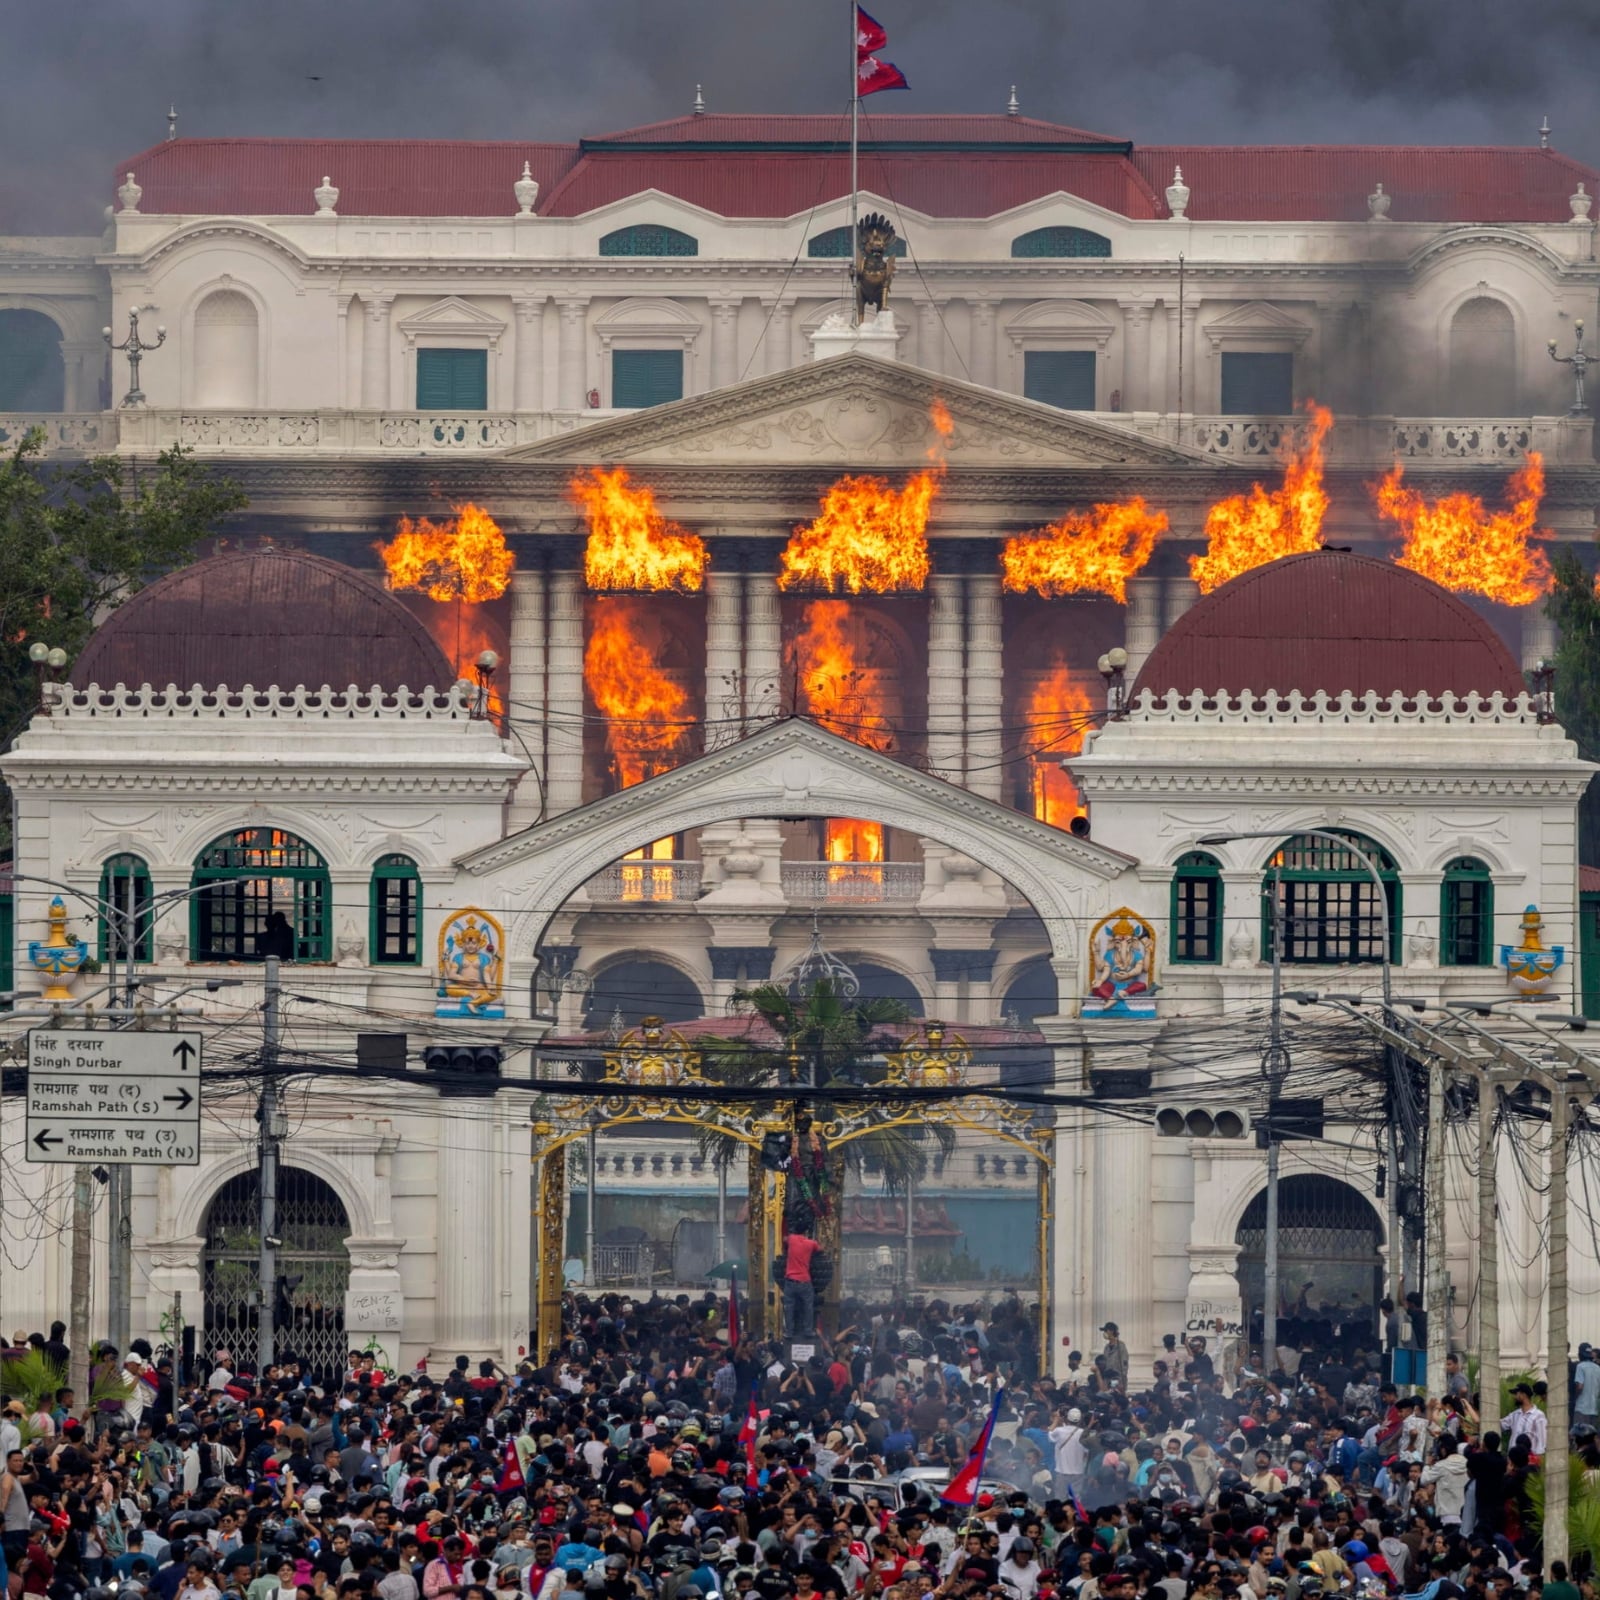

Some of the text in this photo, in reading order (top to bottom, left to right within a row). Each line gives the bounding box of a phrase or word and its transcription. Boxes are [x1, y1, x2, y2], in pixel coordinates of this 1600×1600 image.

[33, 1056, 122, 1069] Singh Durbar
[33, 1083, 79, 1095] रामशाह
[89, 1084, 109, 1095] पथ
[32, 1100, 159, 1114] Ramshah Path (S)
[69, 1129, 116, 1141] रामशाह
[125, 1130, 145, 1141] पथ
[67, 1146, 194, 1159] Ramshah Path (N)
